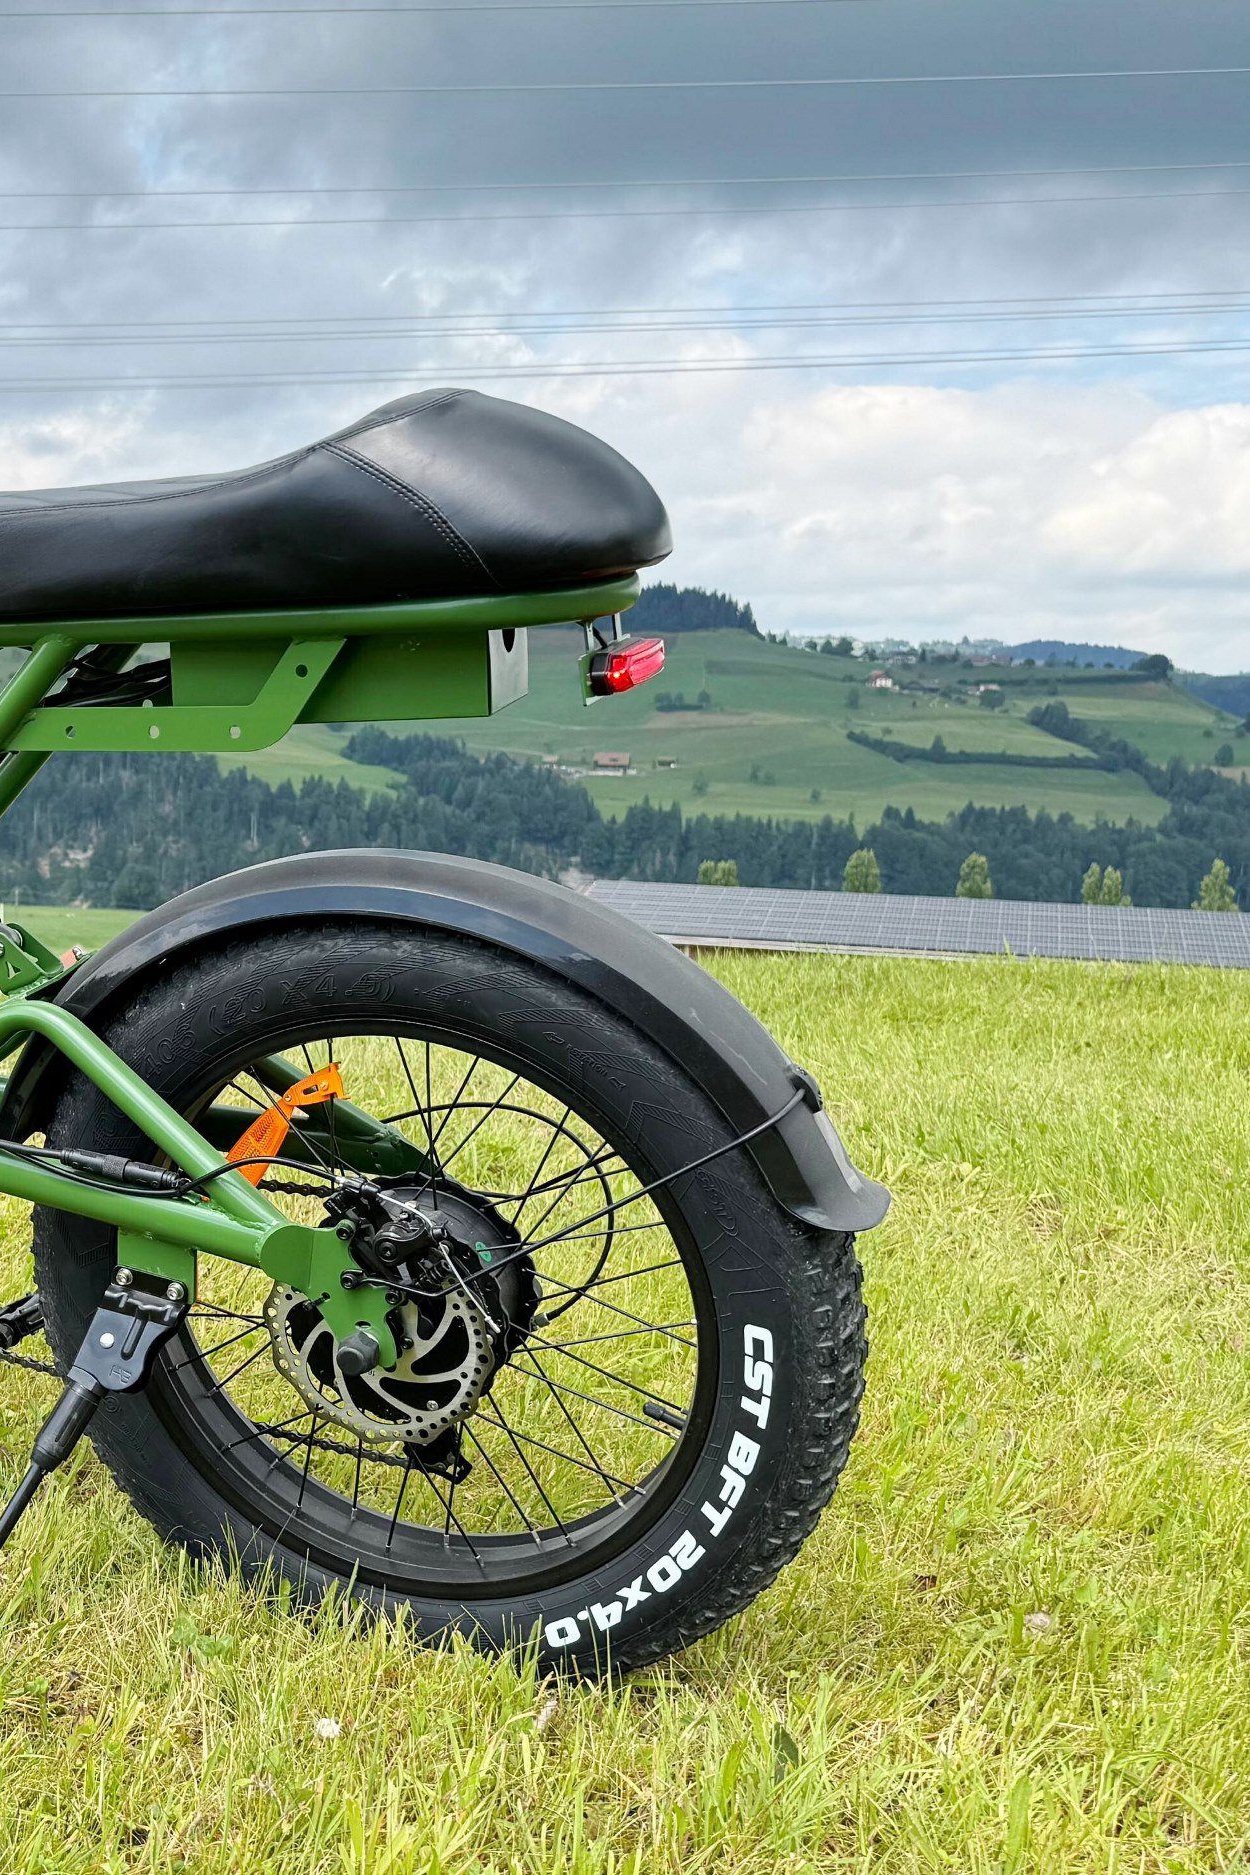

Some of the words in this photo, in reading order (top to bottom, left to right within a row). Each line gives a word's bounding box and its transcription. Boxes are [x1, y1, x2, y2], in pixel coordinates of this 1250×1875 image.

[740, 1323, 774, 1430] CST
[700, 1430, 761, 1538] BFT
[544, 1530, 706, 1648] 20x4.0
